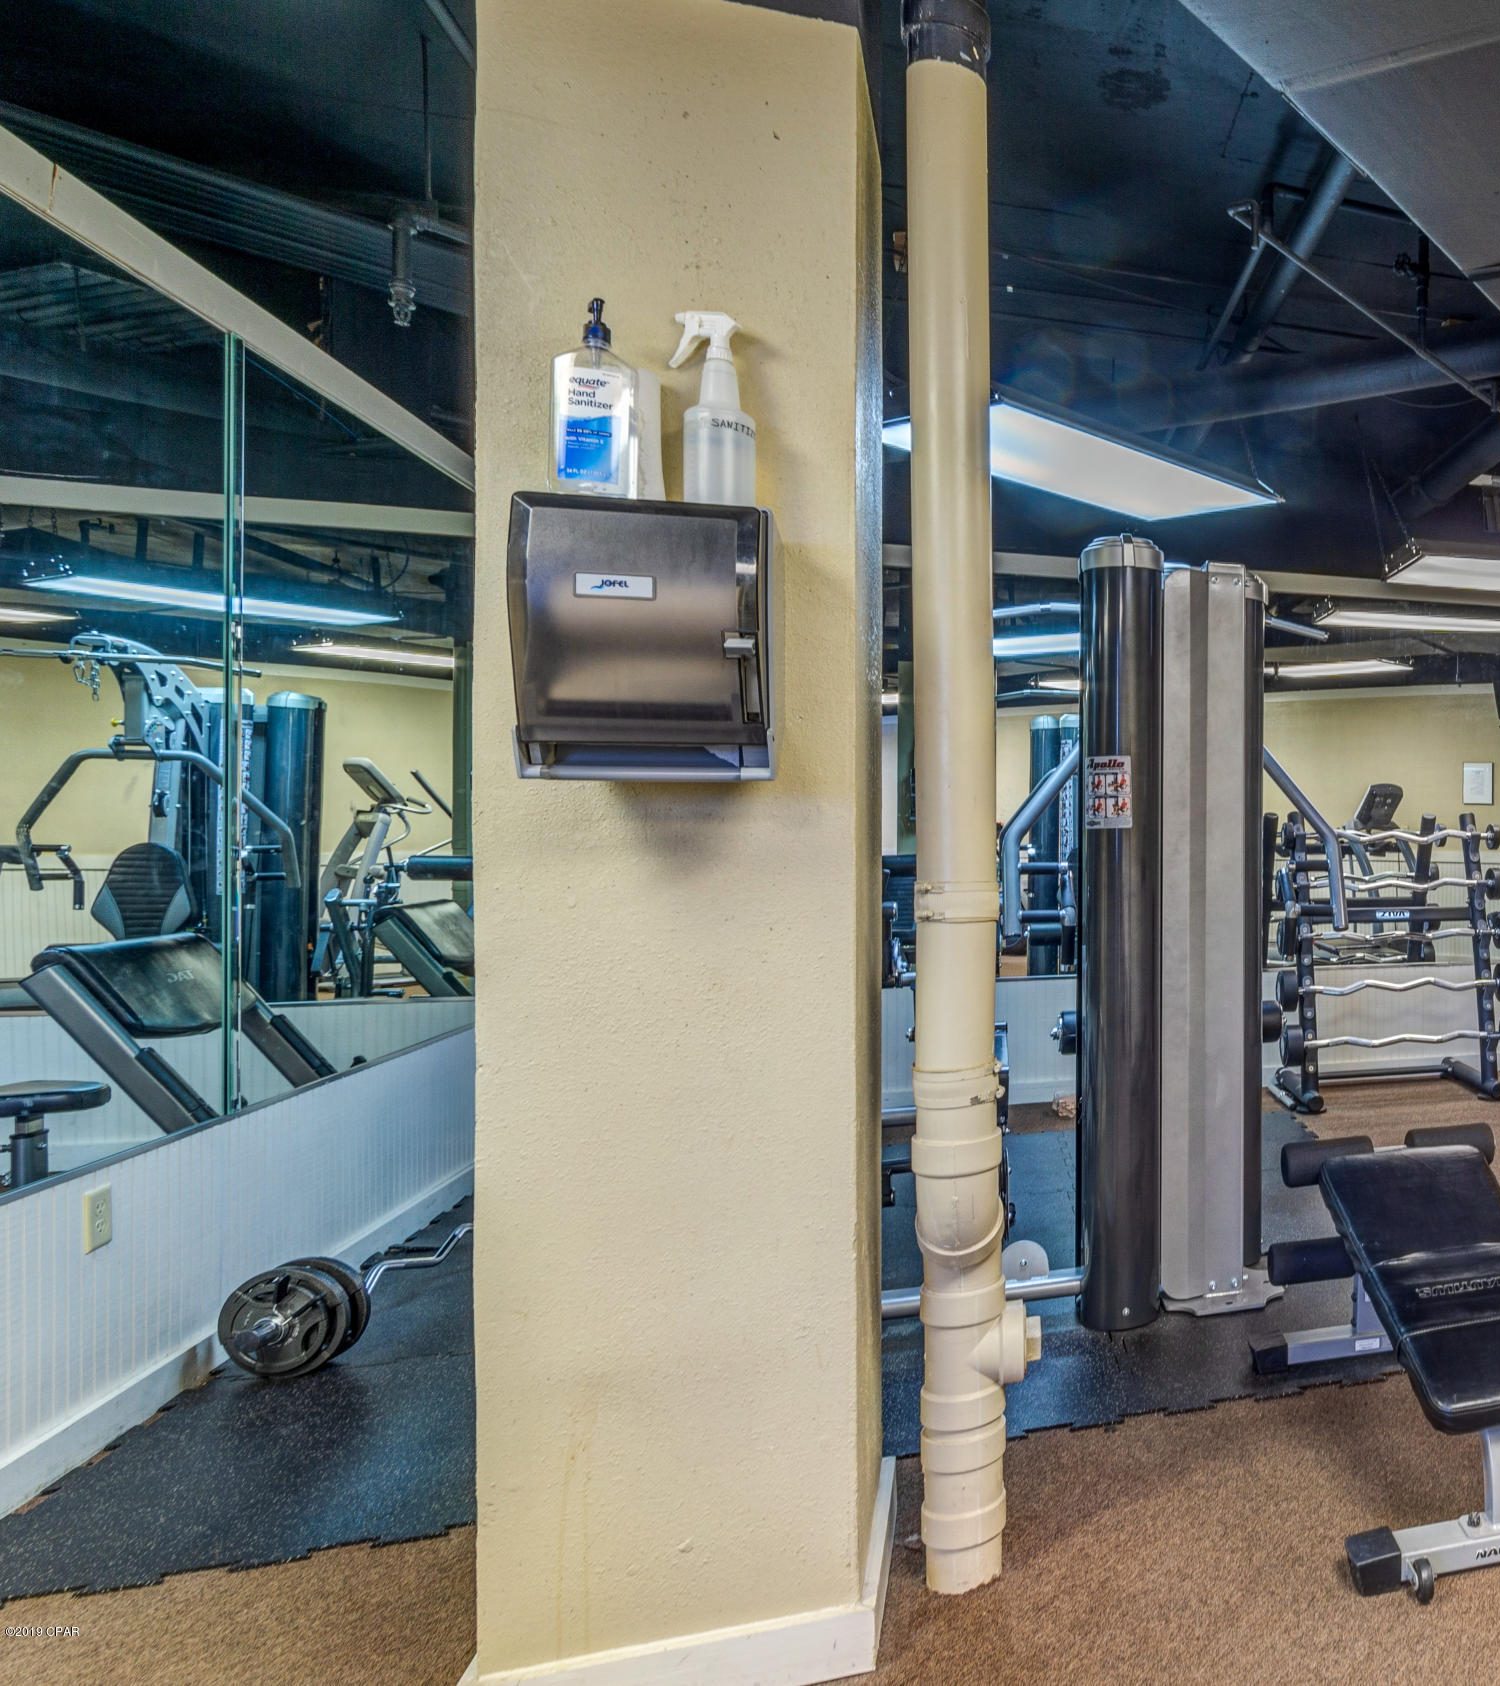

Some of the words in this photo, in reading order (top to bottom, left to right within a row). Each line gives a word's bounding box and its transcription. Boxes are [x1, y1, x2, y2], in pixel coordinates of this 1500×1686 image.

[568, 376, 607, 388] equate
[568, 387, 596, 398] Hand
[568, 397, 613, 410] Sanitizer
[593, 579, 629, 590] JOFEL
[1087, 758, 1125, 771] Apollo
